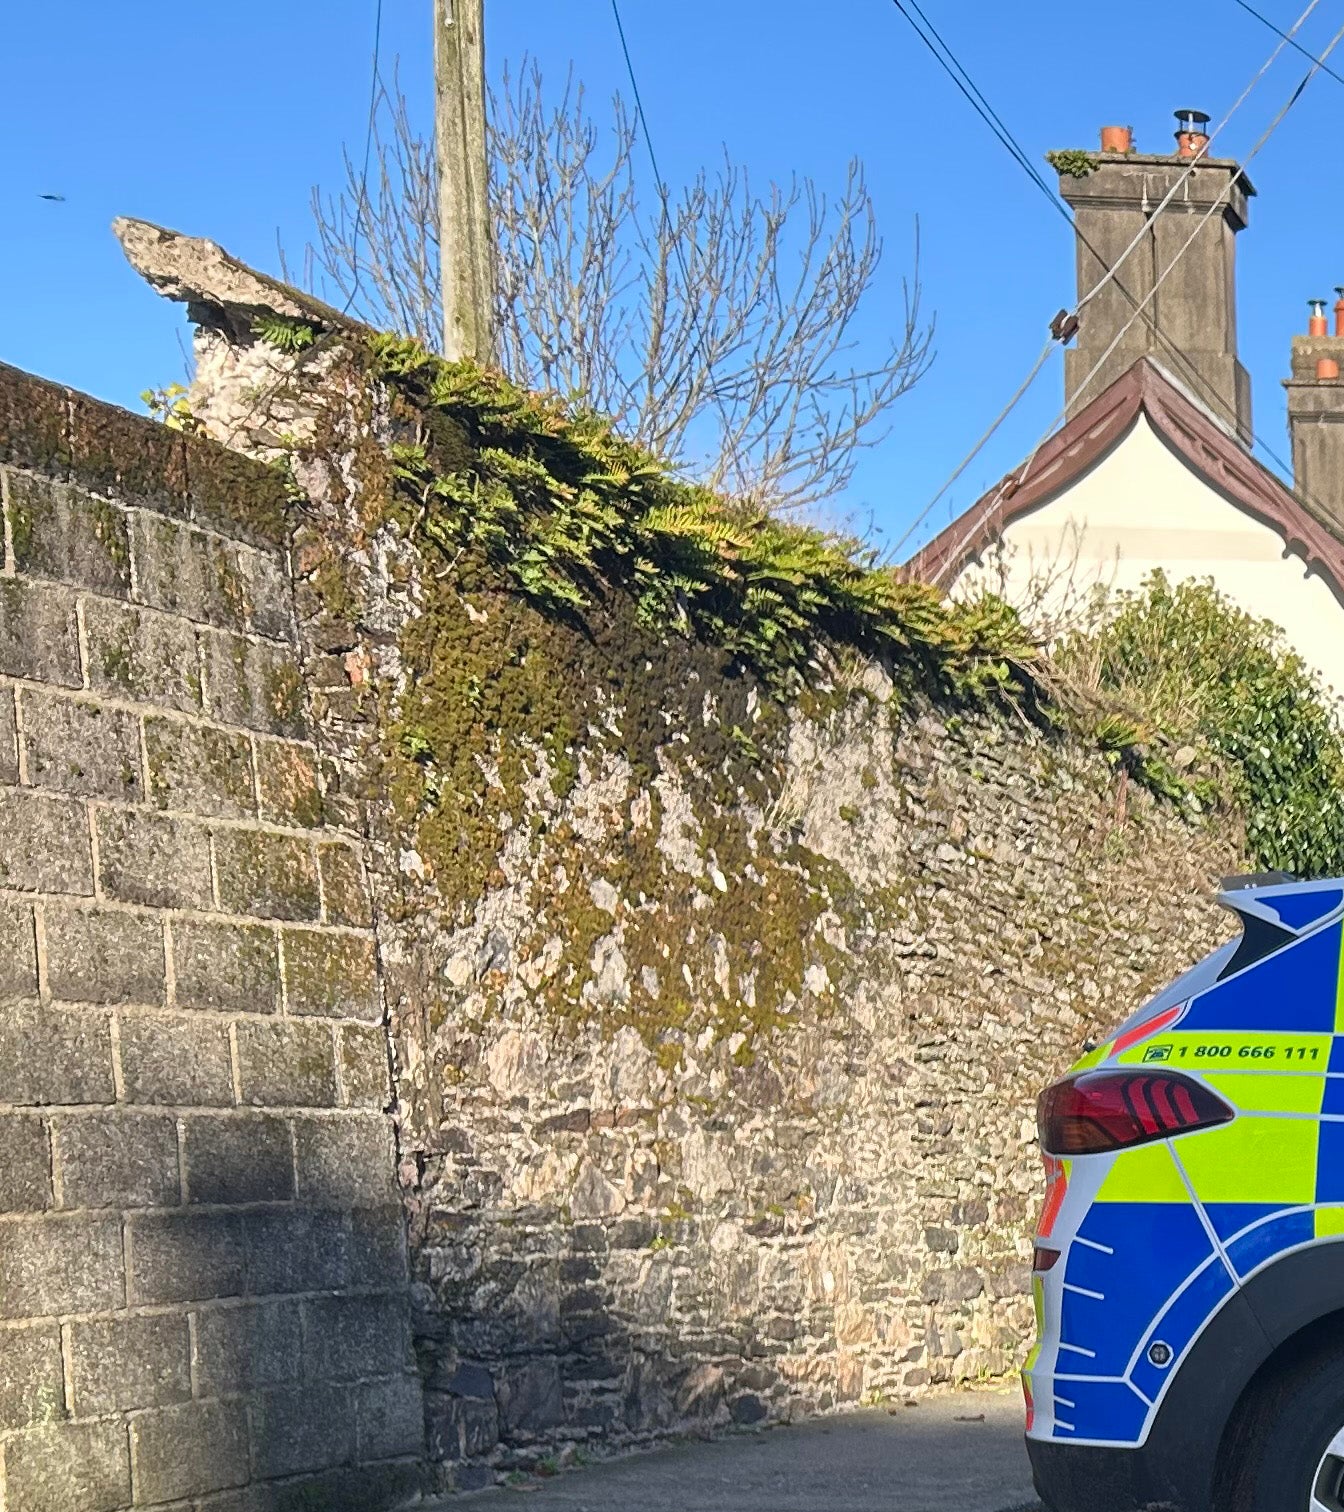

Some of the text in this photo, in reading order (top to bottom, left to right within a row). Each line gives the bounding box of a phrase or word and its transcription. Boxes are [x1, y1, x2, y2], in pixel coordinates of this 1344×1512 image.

[1178, 1046, 1320, 1060] 1 800 666 111
